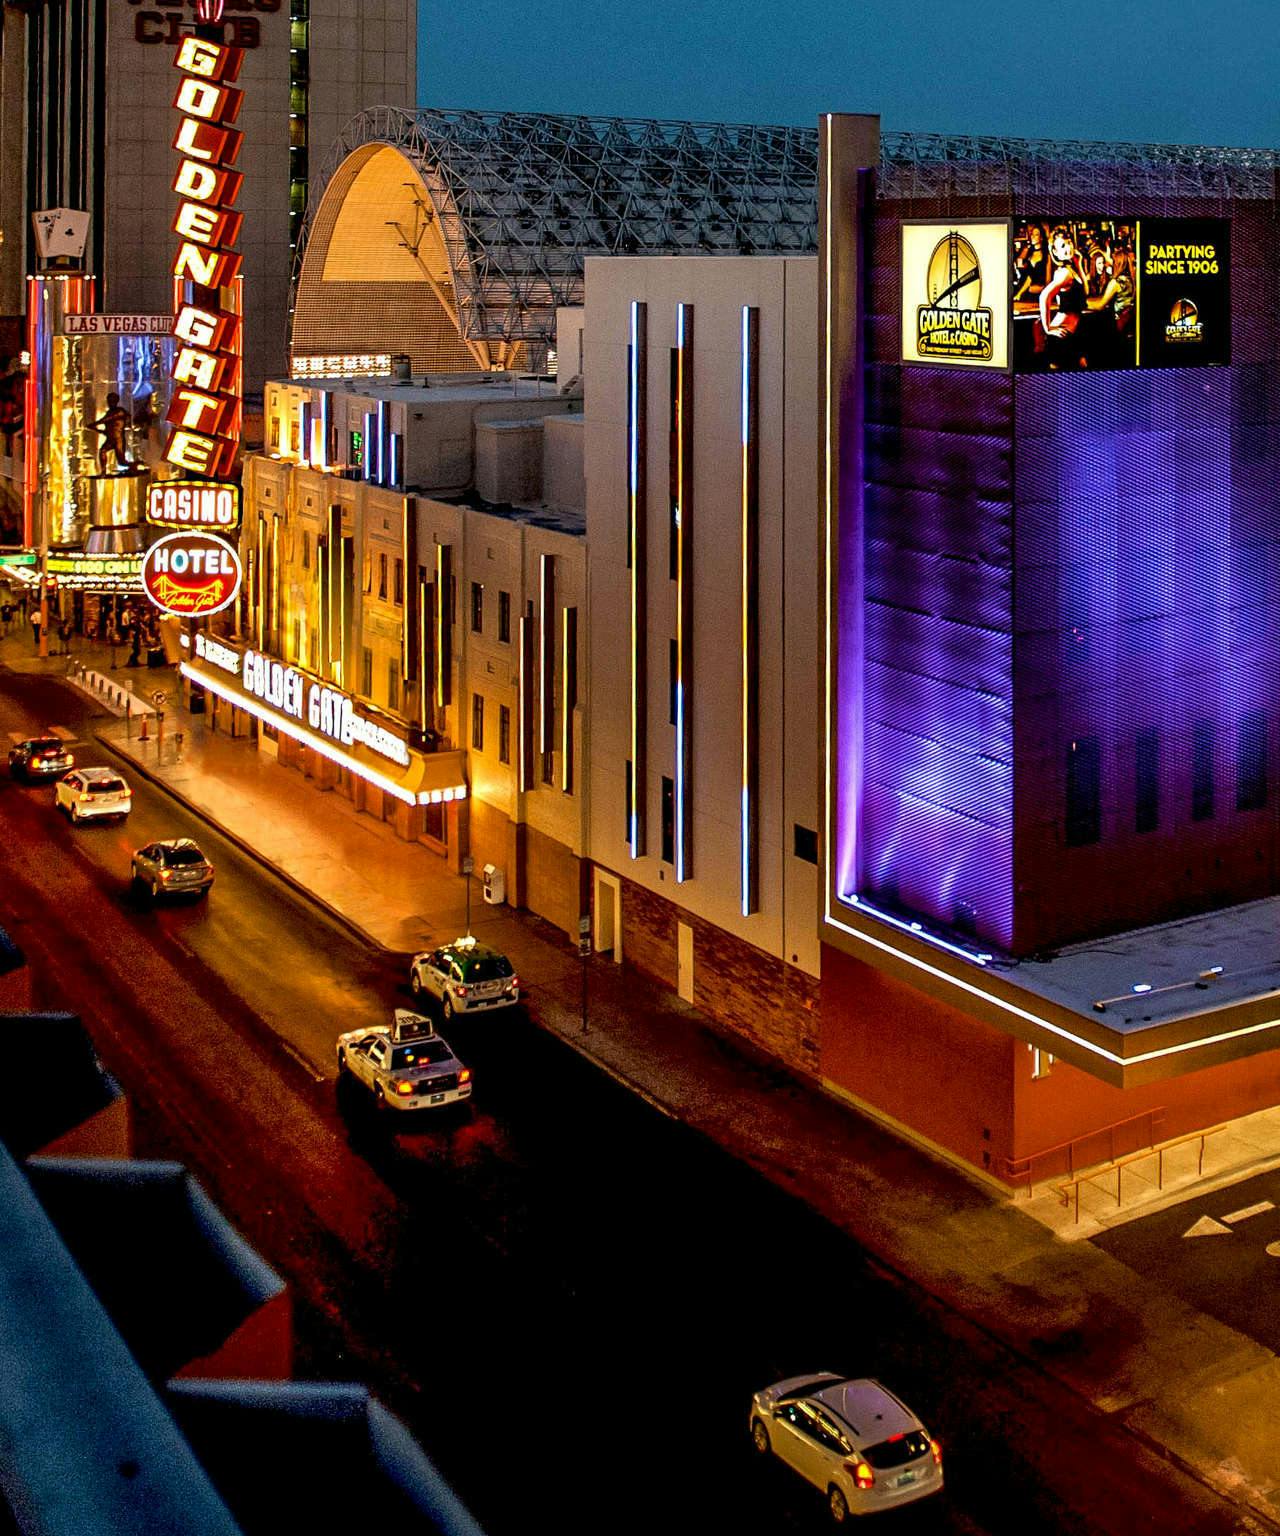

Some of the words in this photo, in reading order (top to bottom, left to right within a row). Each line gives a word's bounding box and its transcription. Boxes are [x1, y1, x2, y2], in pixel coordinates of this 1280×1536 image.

[135, 11, 260, 48] CLB
[174, 36, 221, 288] GOLDEN
[1149, 244, 1216, 259] PARTYING
[1145, 260, 1185, 275] SINCE
[1187, 260, 1219, 275] 1906
[69, 317, 98, 332] LAS
[103, 317, 147, 332] VEGAS
[920, 310, 961, 334] GOLDEN
[961, 312, 990, 339] GATE
[929, 330, 950, 344] HOTEL
[955, 330, 979, 346] CASINO
[166, 306, 219, 473] GATE
[150, 488, 233, 524] CASINO
[154, 547, 235, 575] HOTEL
[243, 649, 305, 721] GOLDEN
[308, 683, 354, 746] GATE
